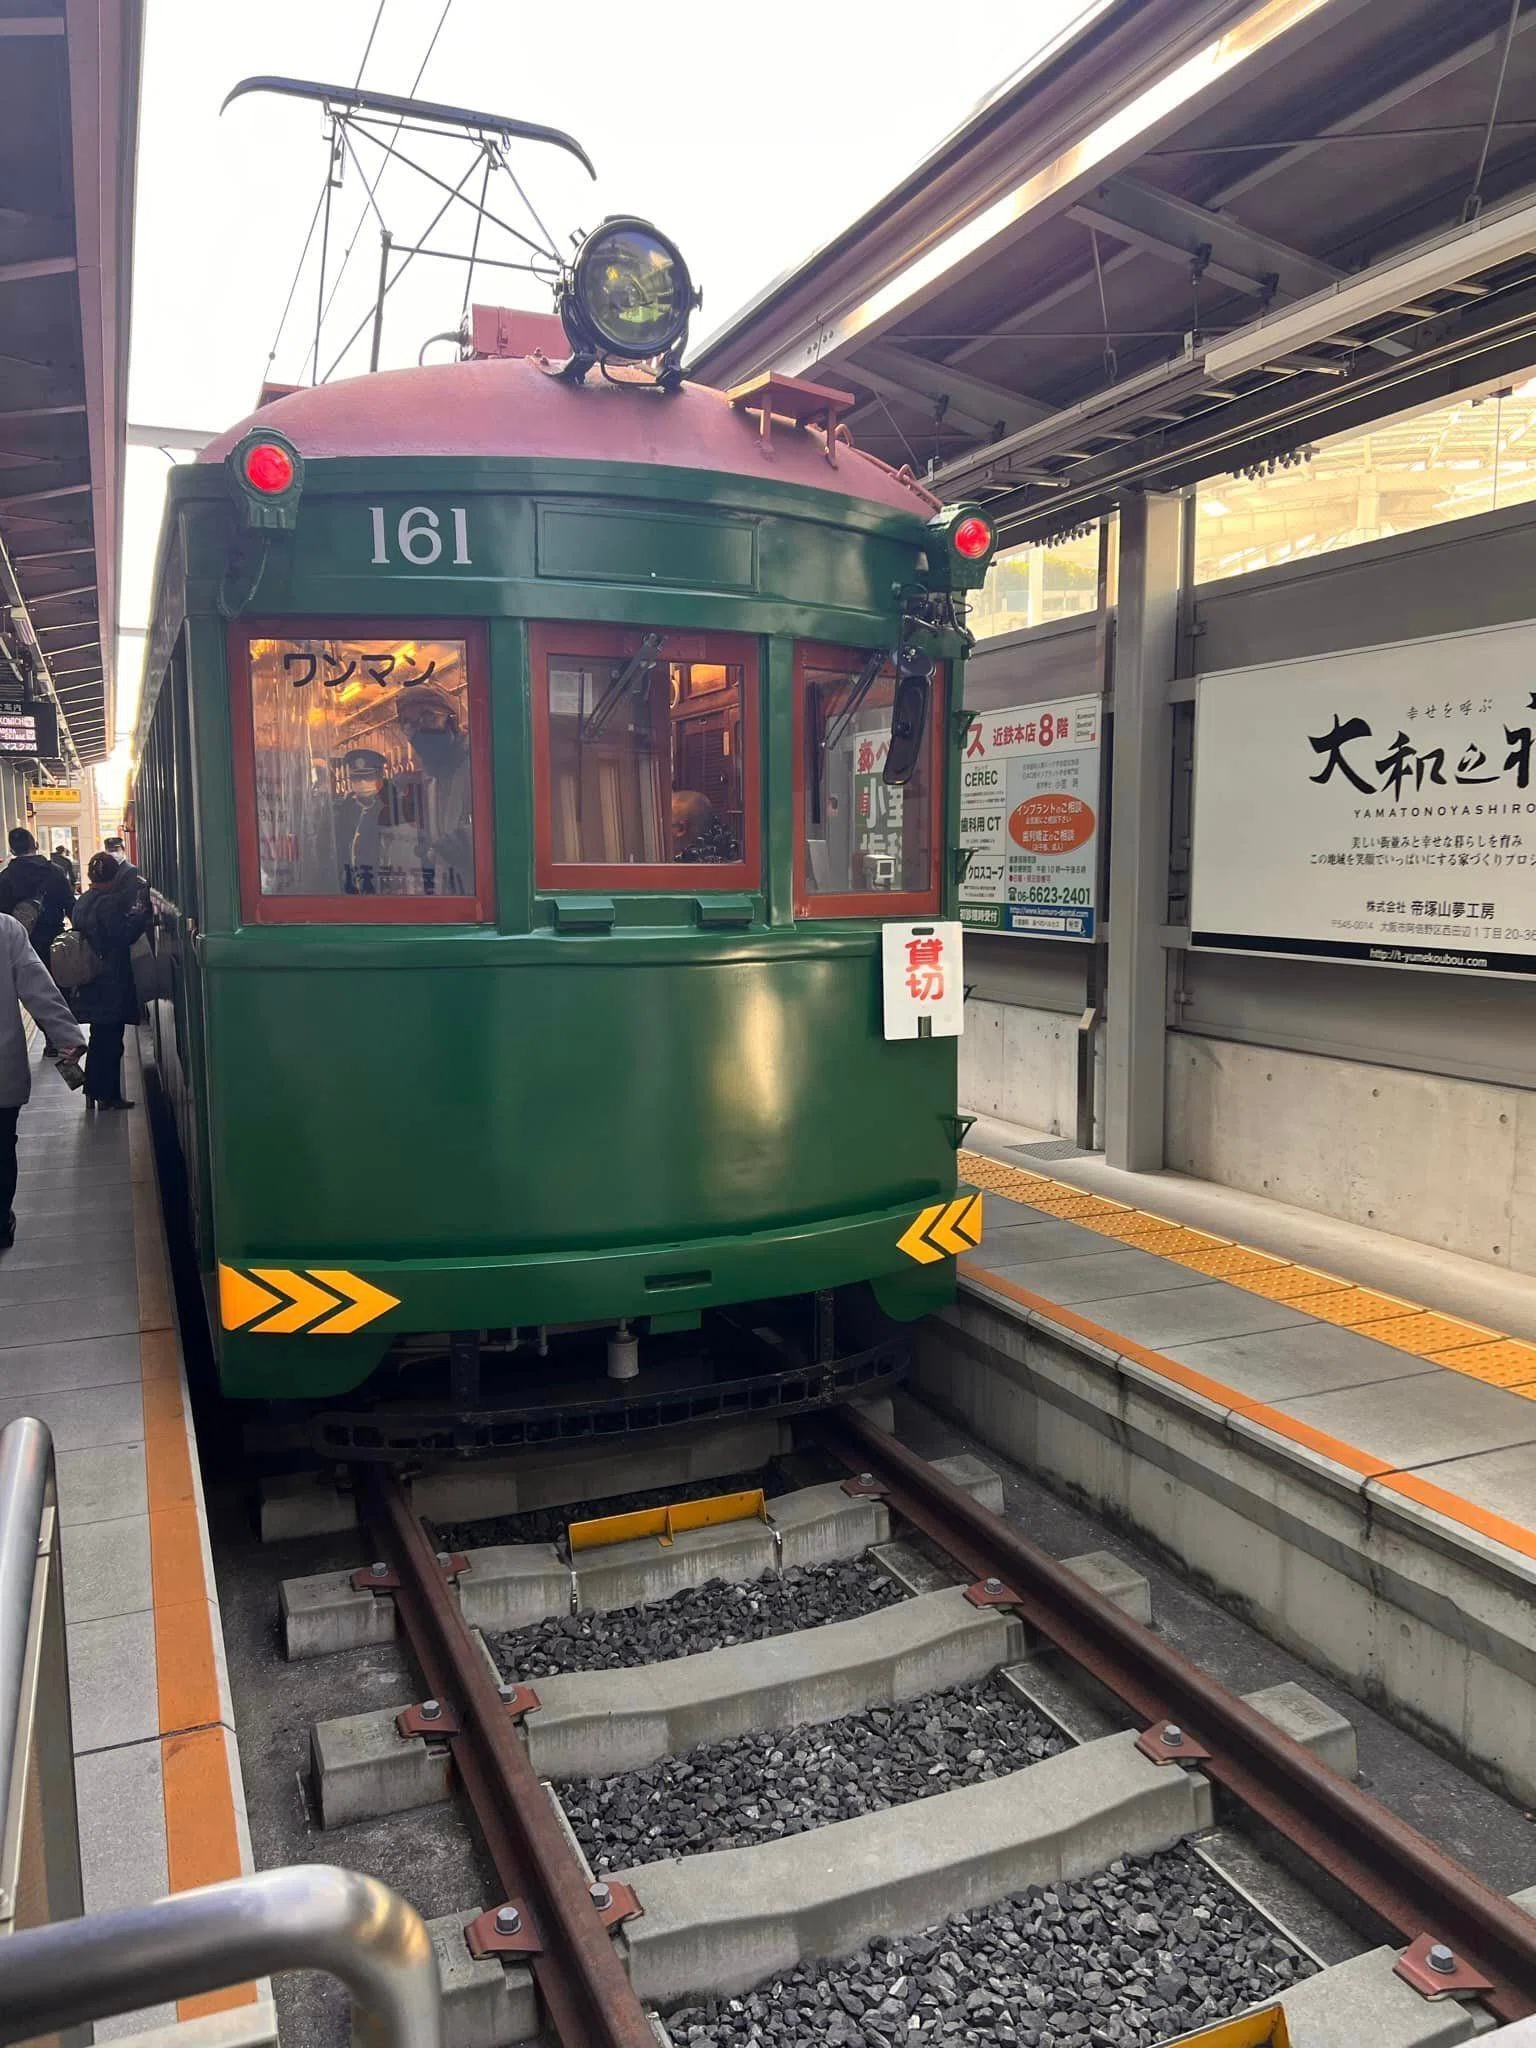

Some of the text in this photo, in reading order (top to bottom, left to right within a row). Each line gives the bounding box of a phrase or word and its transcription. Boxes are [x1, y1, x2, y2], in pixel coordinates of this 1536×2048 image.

[368, 506, 472, 565] 161
[284, 653, 436, 687] ワンマン
[964, 770, 998, 787] CEREC
[1354, 803, 1536, 819] YAMATONOYASHIRO
[987, 817, 1001, 831] CT
[1018, 887, 1090, 905] 06-6623-2401
[1367, 901, 1495, 920] 株式会社 帝塚山夢工房
[905, 938, 944, 1001] 貸切
